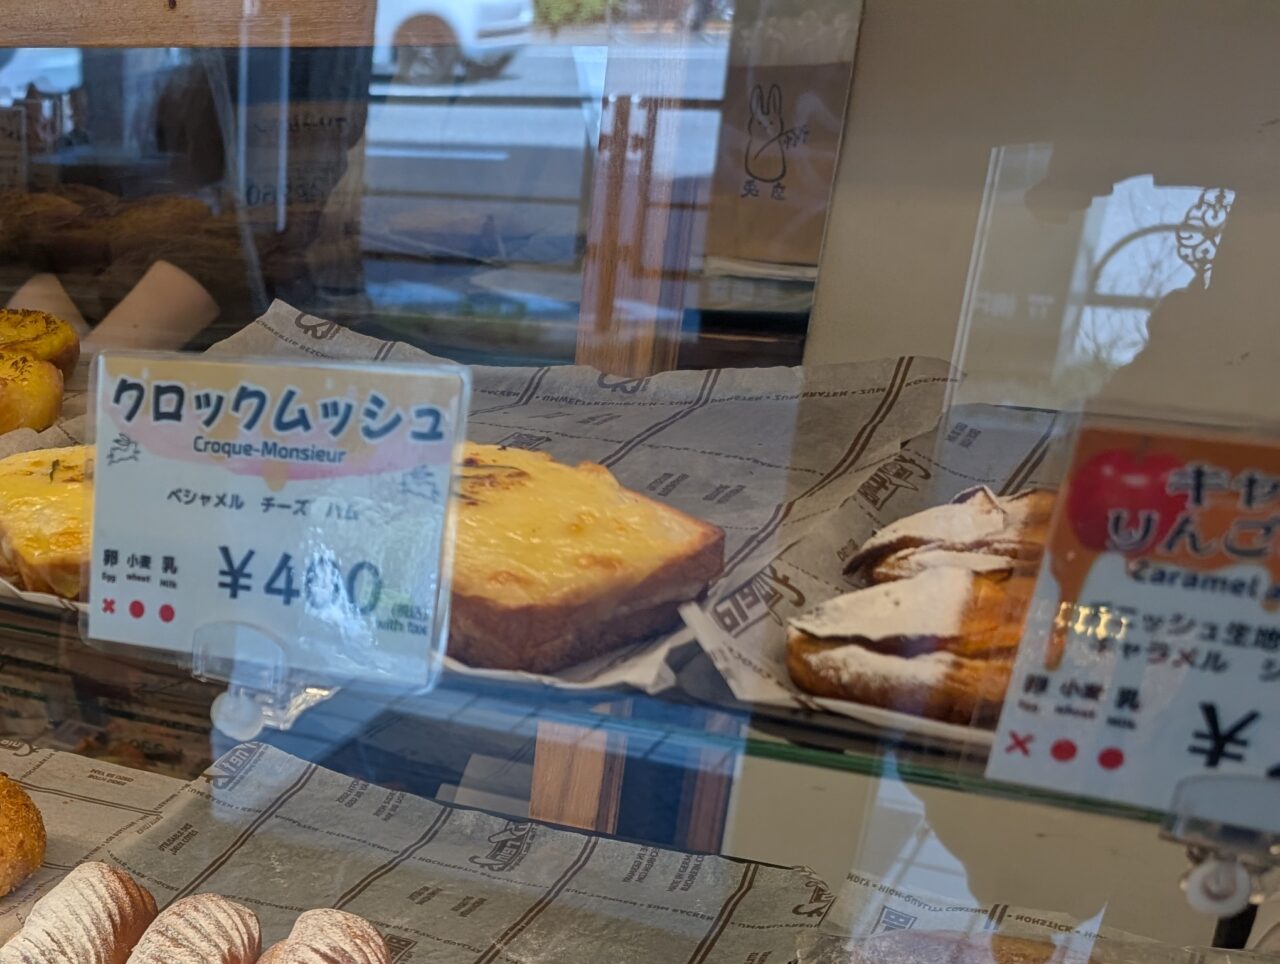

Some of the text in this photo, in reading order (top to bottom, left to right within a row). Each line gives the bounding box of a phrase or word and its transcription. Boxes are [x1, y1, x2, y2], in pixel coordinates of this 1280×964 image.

[113, 377, 445, 442] クロックムッシュ
[193, 435, 347, 464] Croque-Monsieur
[260, 498, 308, 516] チーズ
[103, 549, 178, 576] 卵 小麦 乳
[1129, 563, 1259, 599] Caramel
[406, 622, 428, 636] tax
